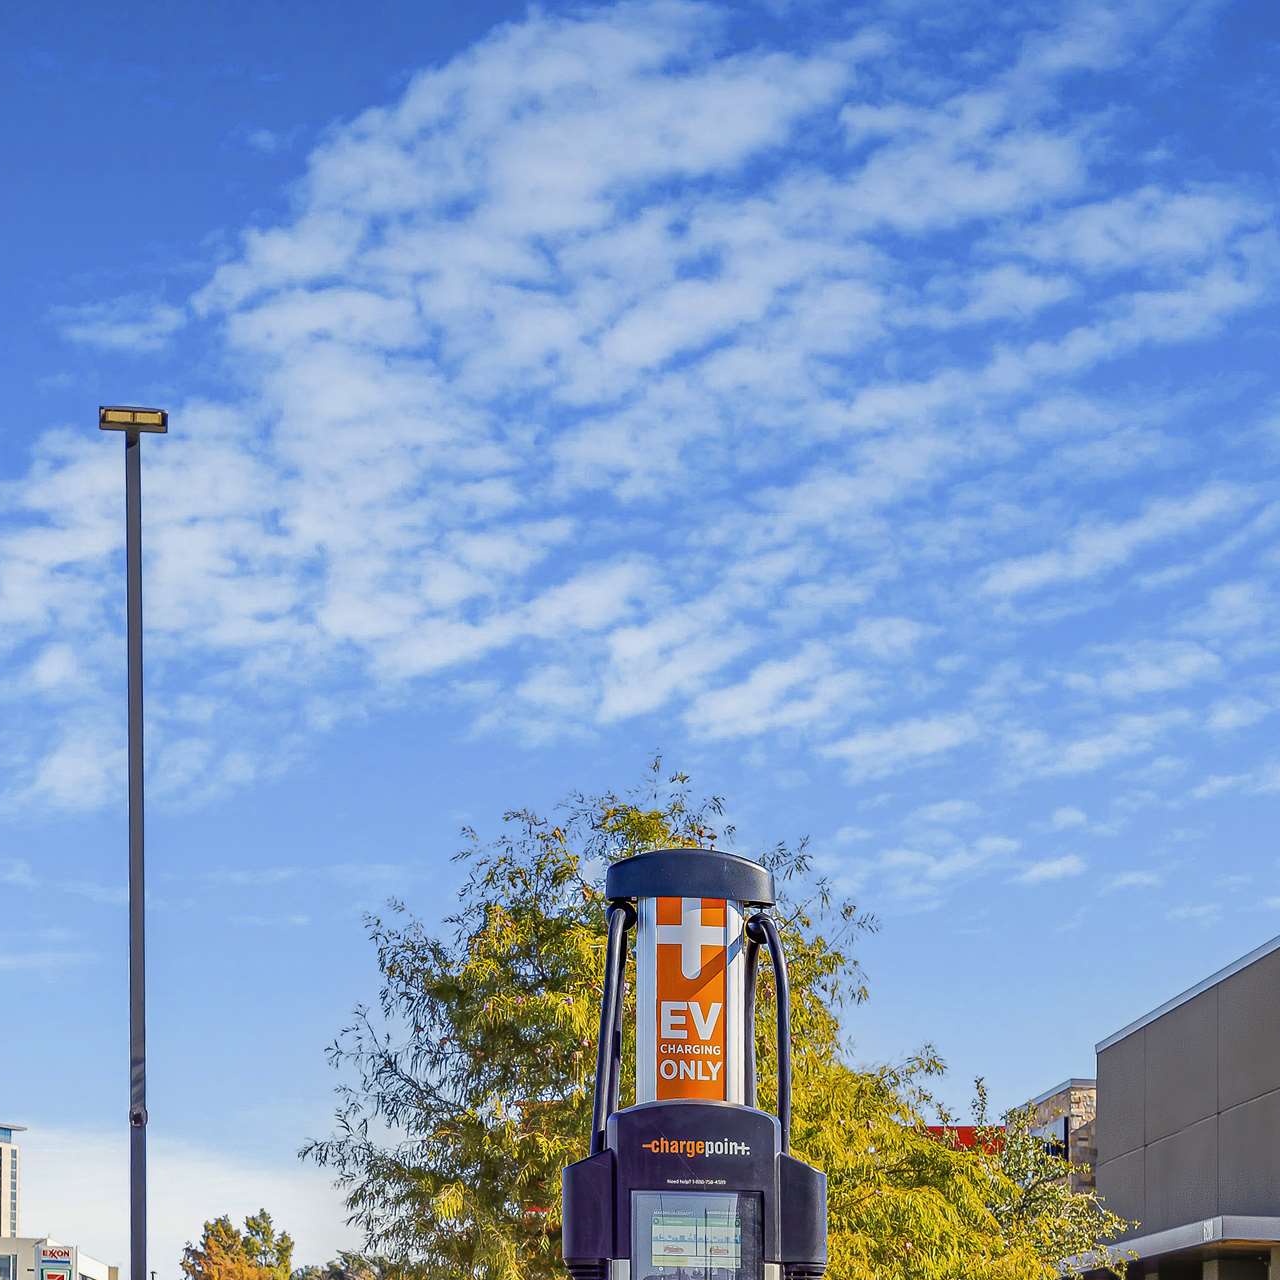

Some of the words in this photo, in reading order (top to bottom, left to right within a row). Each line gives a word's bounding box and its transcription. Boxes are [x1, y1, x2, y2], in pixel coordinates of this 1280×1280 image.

[660, 1001, 722, 1040] EV
[660, 1044, 721, 1056] CHARGING
[660, 1059, 723, 1081] ONLY
[42, 1249, 70, 1259] EXXON
